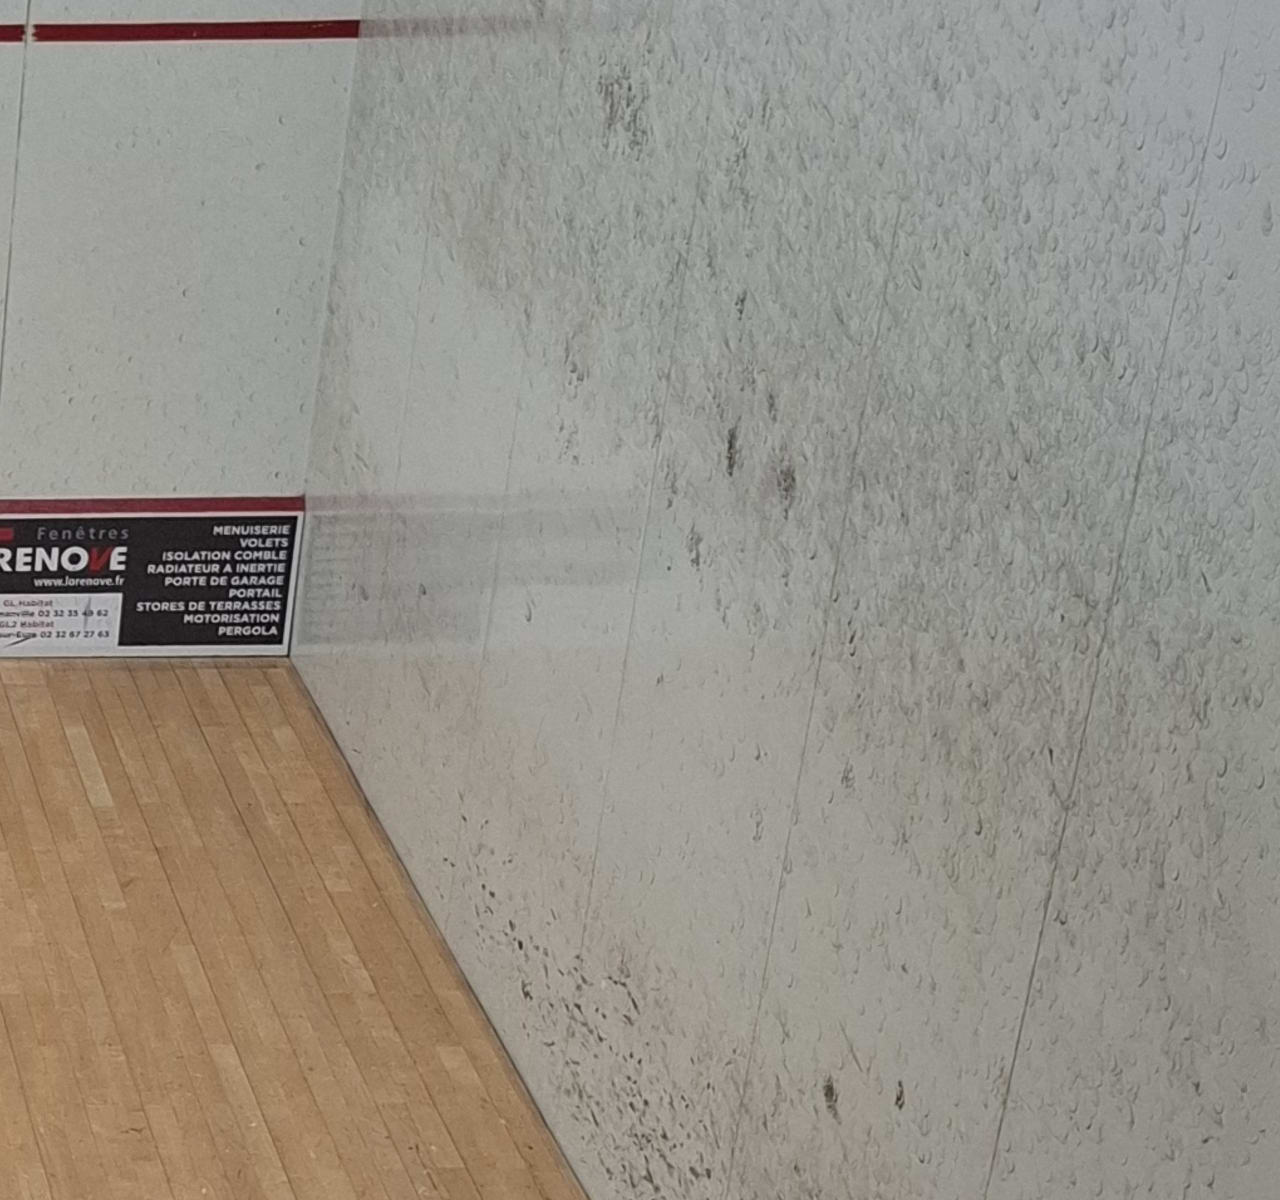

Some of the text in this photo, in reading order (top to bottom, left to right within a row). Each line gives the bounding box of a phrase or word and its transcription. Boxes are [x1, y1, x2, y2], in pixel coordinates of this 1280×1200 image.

[37, 527, 129, 541] Fenêtres
[213, 525, 290, 536] MENUISERIE
[240, 538, 289, 548] VOLETS
[162, 550, 287, 561] ISOLATION COMBLE
[147, 563, 286, 574] RADIATEUR A INERTIE
[34, 575, 125, 587] www.lorenove.fr
[164, 576, 284, 587] PORTE DE GARAGE
[228, 588, 282, 598] PORTAIL
[136, 601, 281, 612] STORES DE TERRASSES
[183, 614, 280, 624] MOTORISATION
[218, 626, 278, 636] PERGOLA
